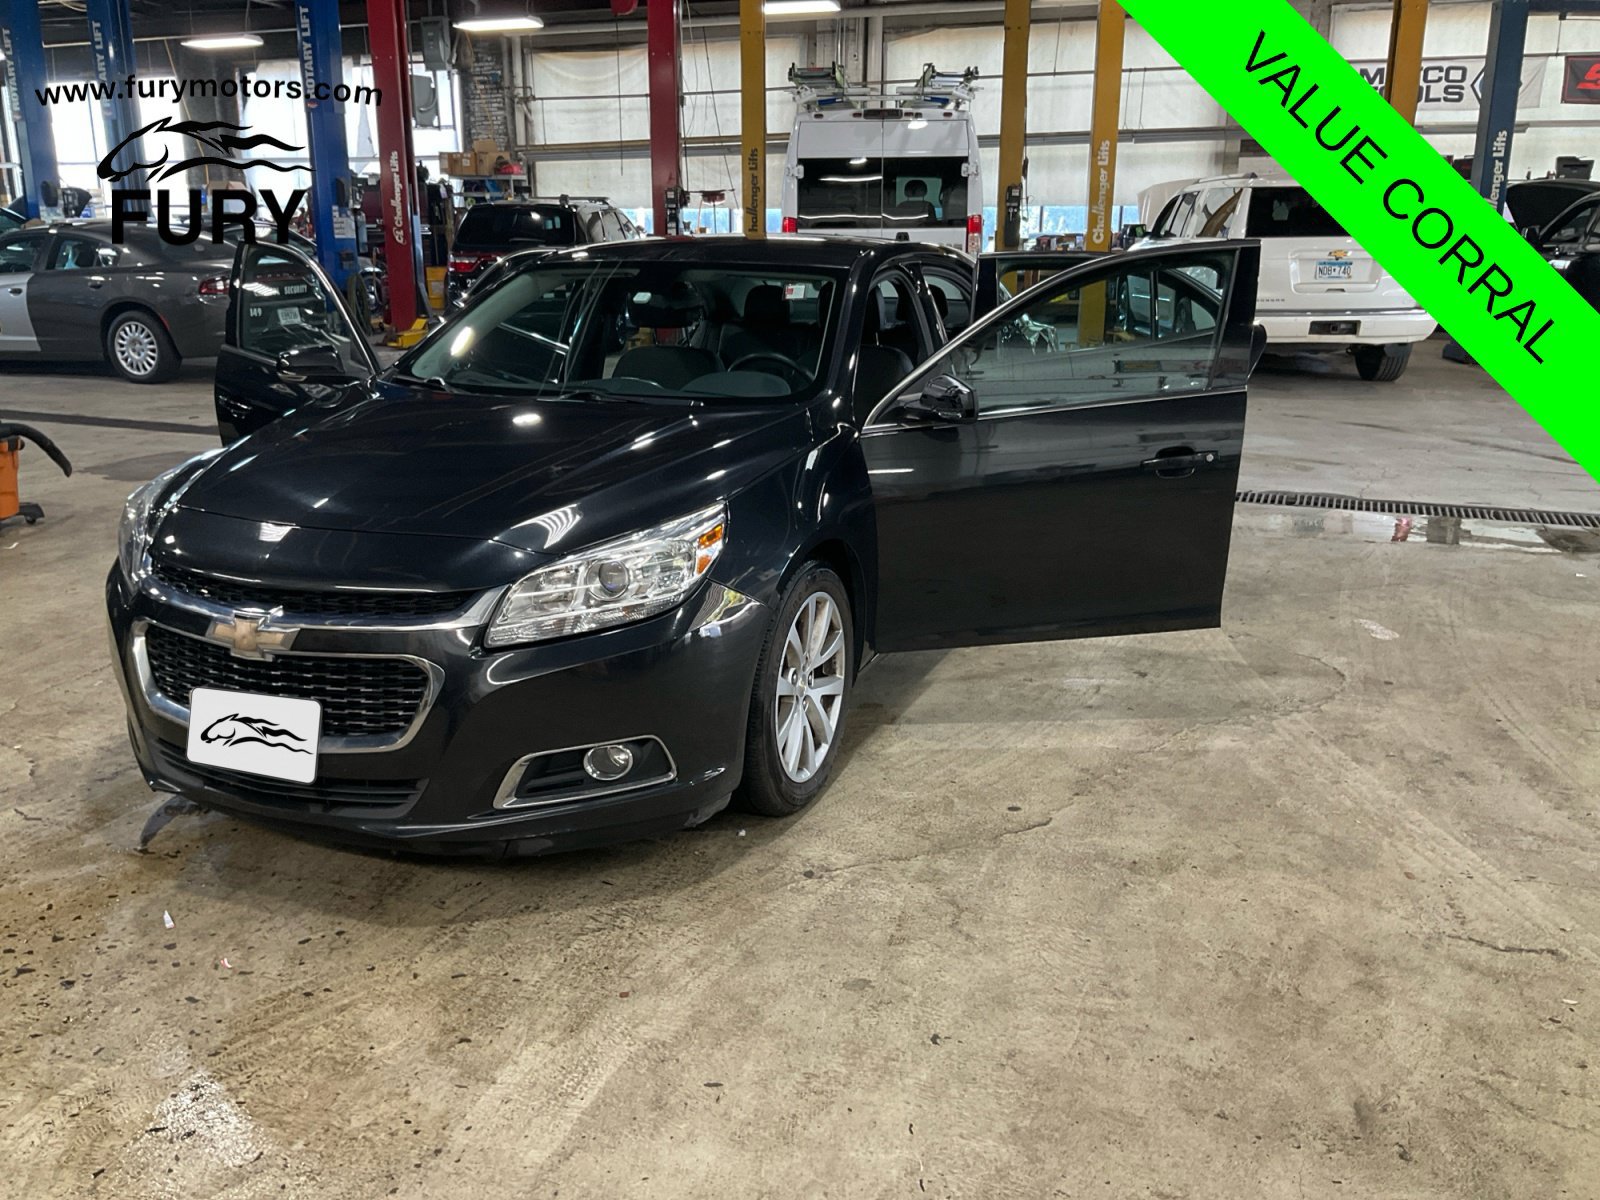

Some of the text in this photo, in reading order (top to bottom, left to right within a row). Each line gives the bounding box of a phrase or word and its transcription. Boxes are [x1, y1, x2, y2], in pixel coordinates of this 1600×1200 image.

[92, 20, 103, 50] LIFT
[299, 5, 312, 37] LIFT
[2, 27, 13, 56] LIFT
[1492, 130, 1507, 157] Lifts
[1091, 140, 1110, 244] Challenger Lifts
